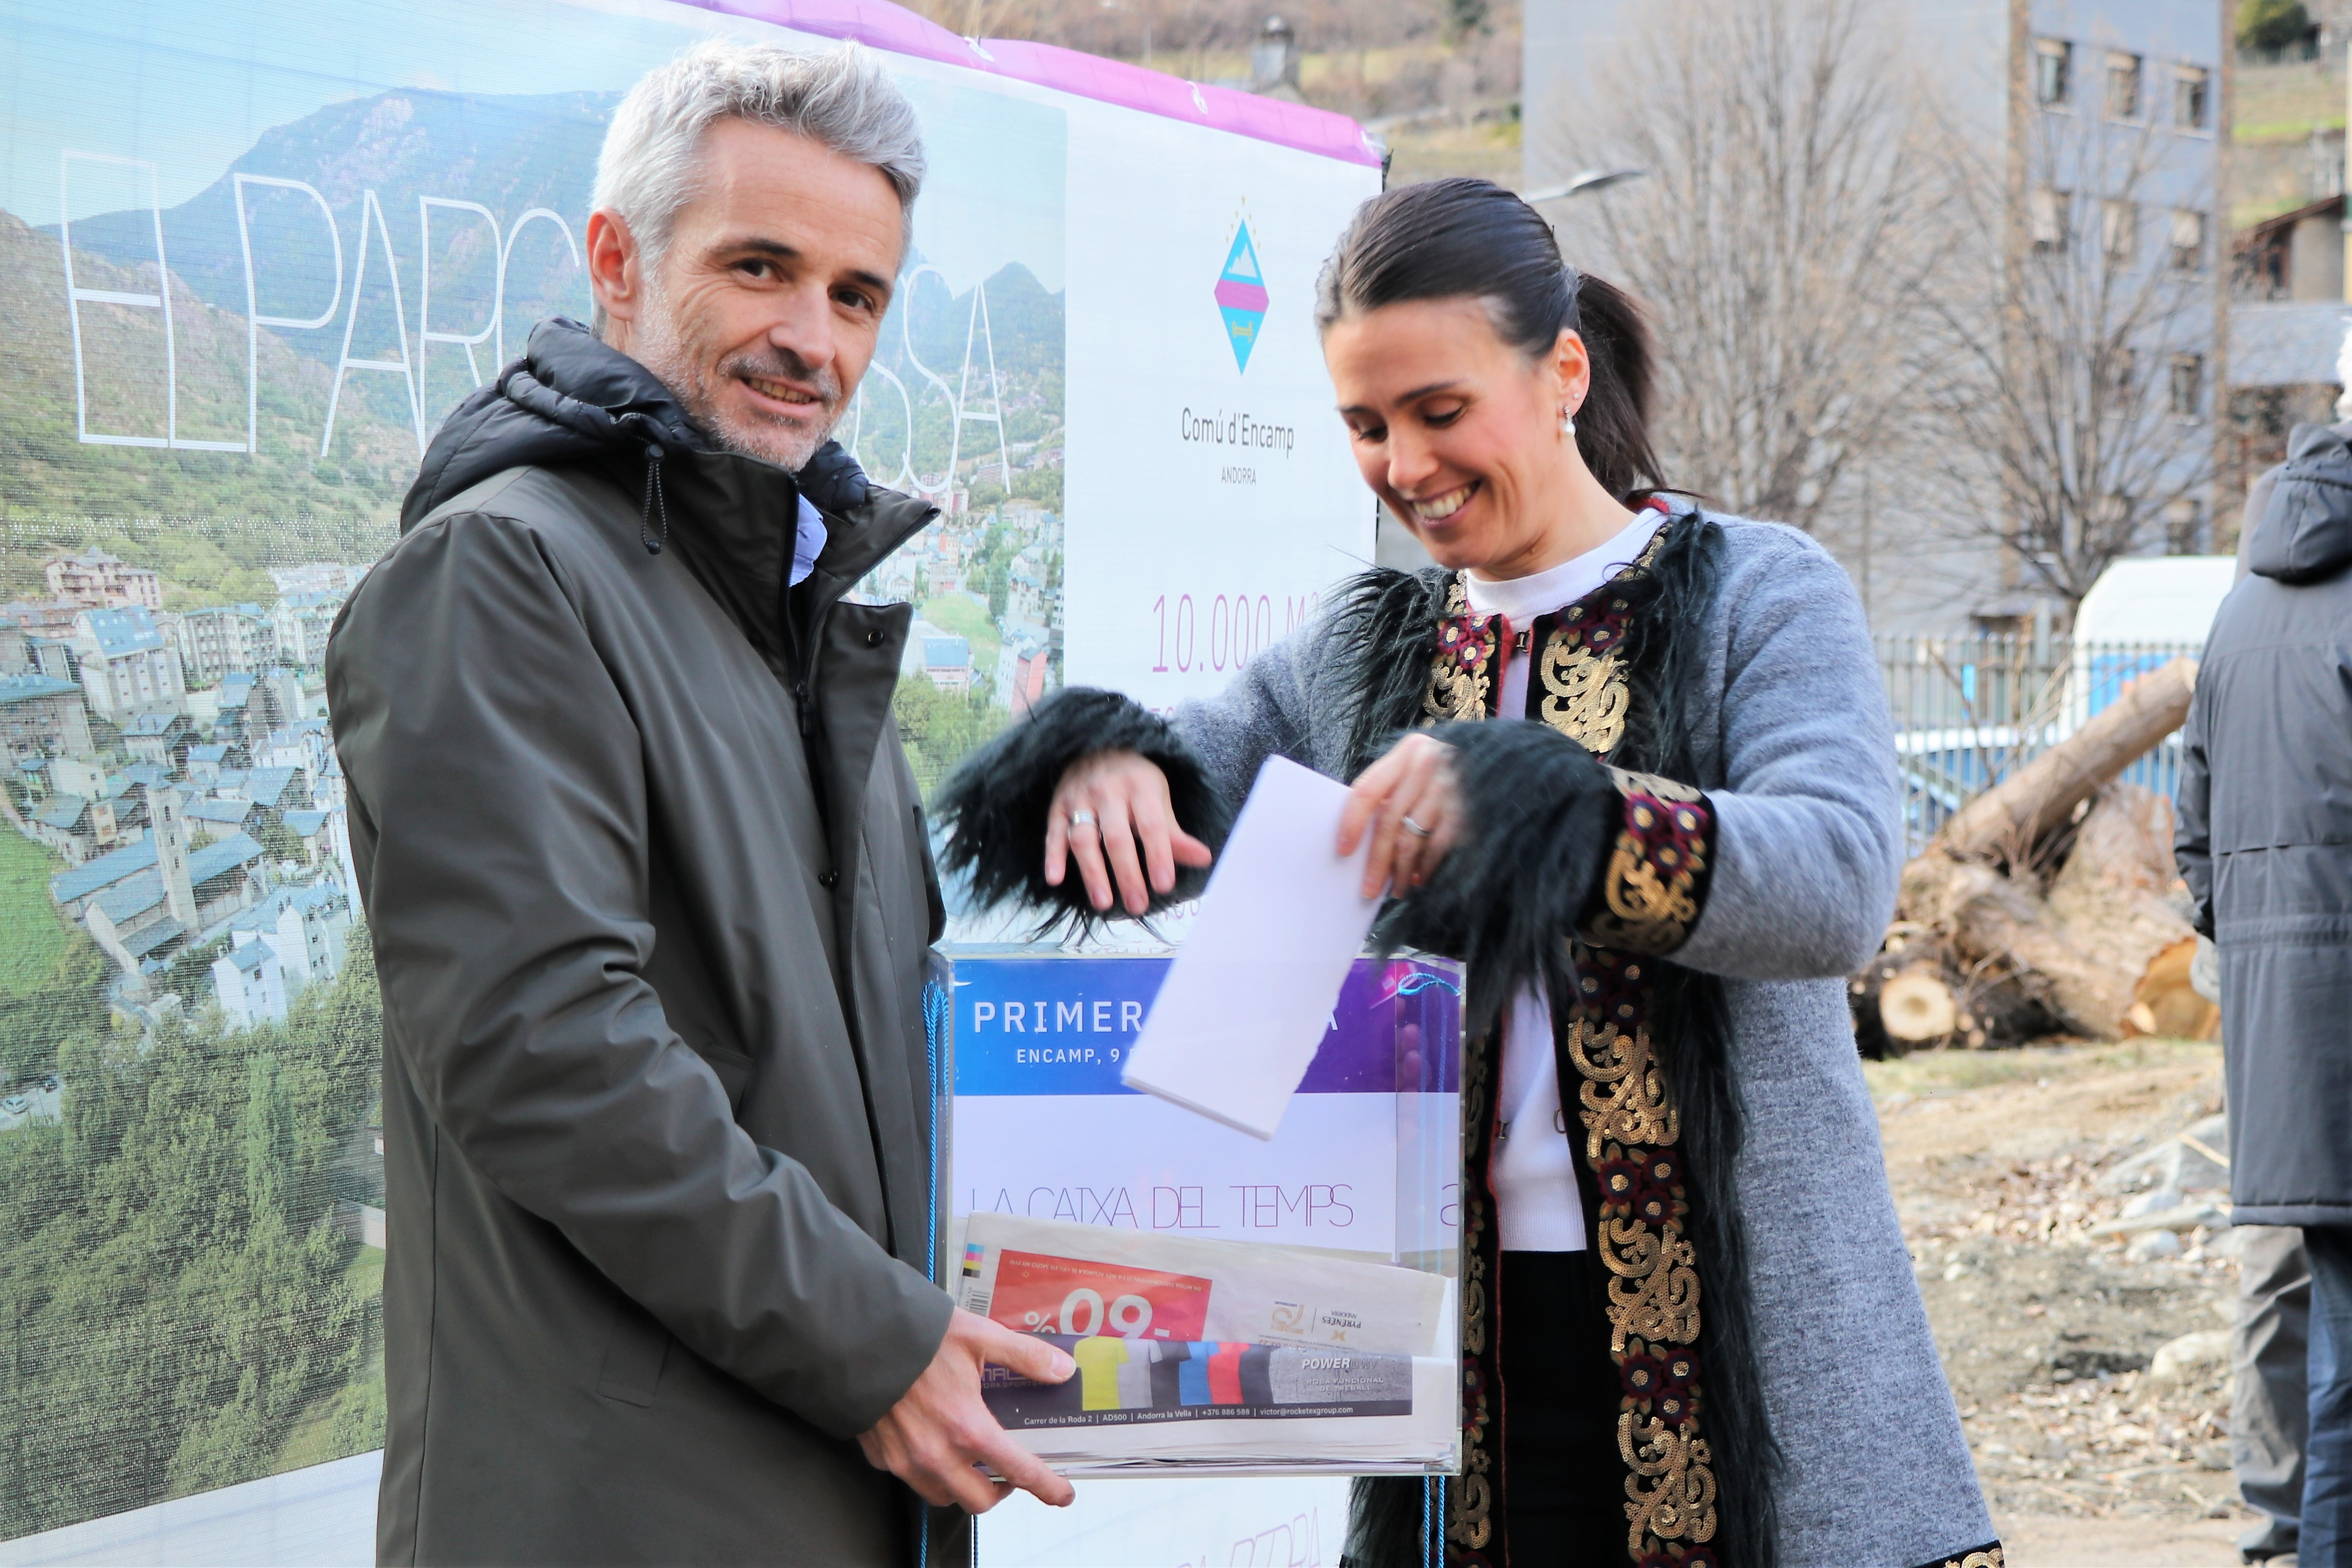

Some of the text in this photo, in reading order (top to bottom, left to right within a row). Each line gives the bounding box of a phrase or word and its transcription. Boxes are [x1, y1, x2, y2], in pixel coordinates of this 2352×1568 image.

[61, 149, 247, 451] EL
[1181, 407, 1294, 459] Comú d'Encamp
[1222, 466, 1257, 485] ANDORRA
[1152, 593, 1271, 673] 10.000
[974, 1001, 1143, 1033] PRIMER
[1016, 1048, 1101, 1065] ENCAMP,
[1110, 1048, 1121, 1063] 9
[1153, 1186, 1220, 1228] DEL
[1229, 1184, 1353, 1228] TEMPS
[1260, 1407, 1353, 1415] victor@rocketexgroup.com
